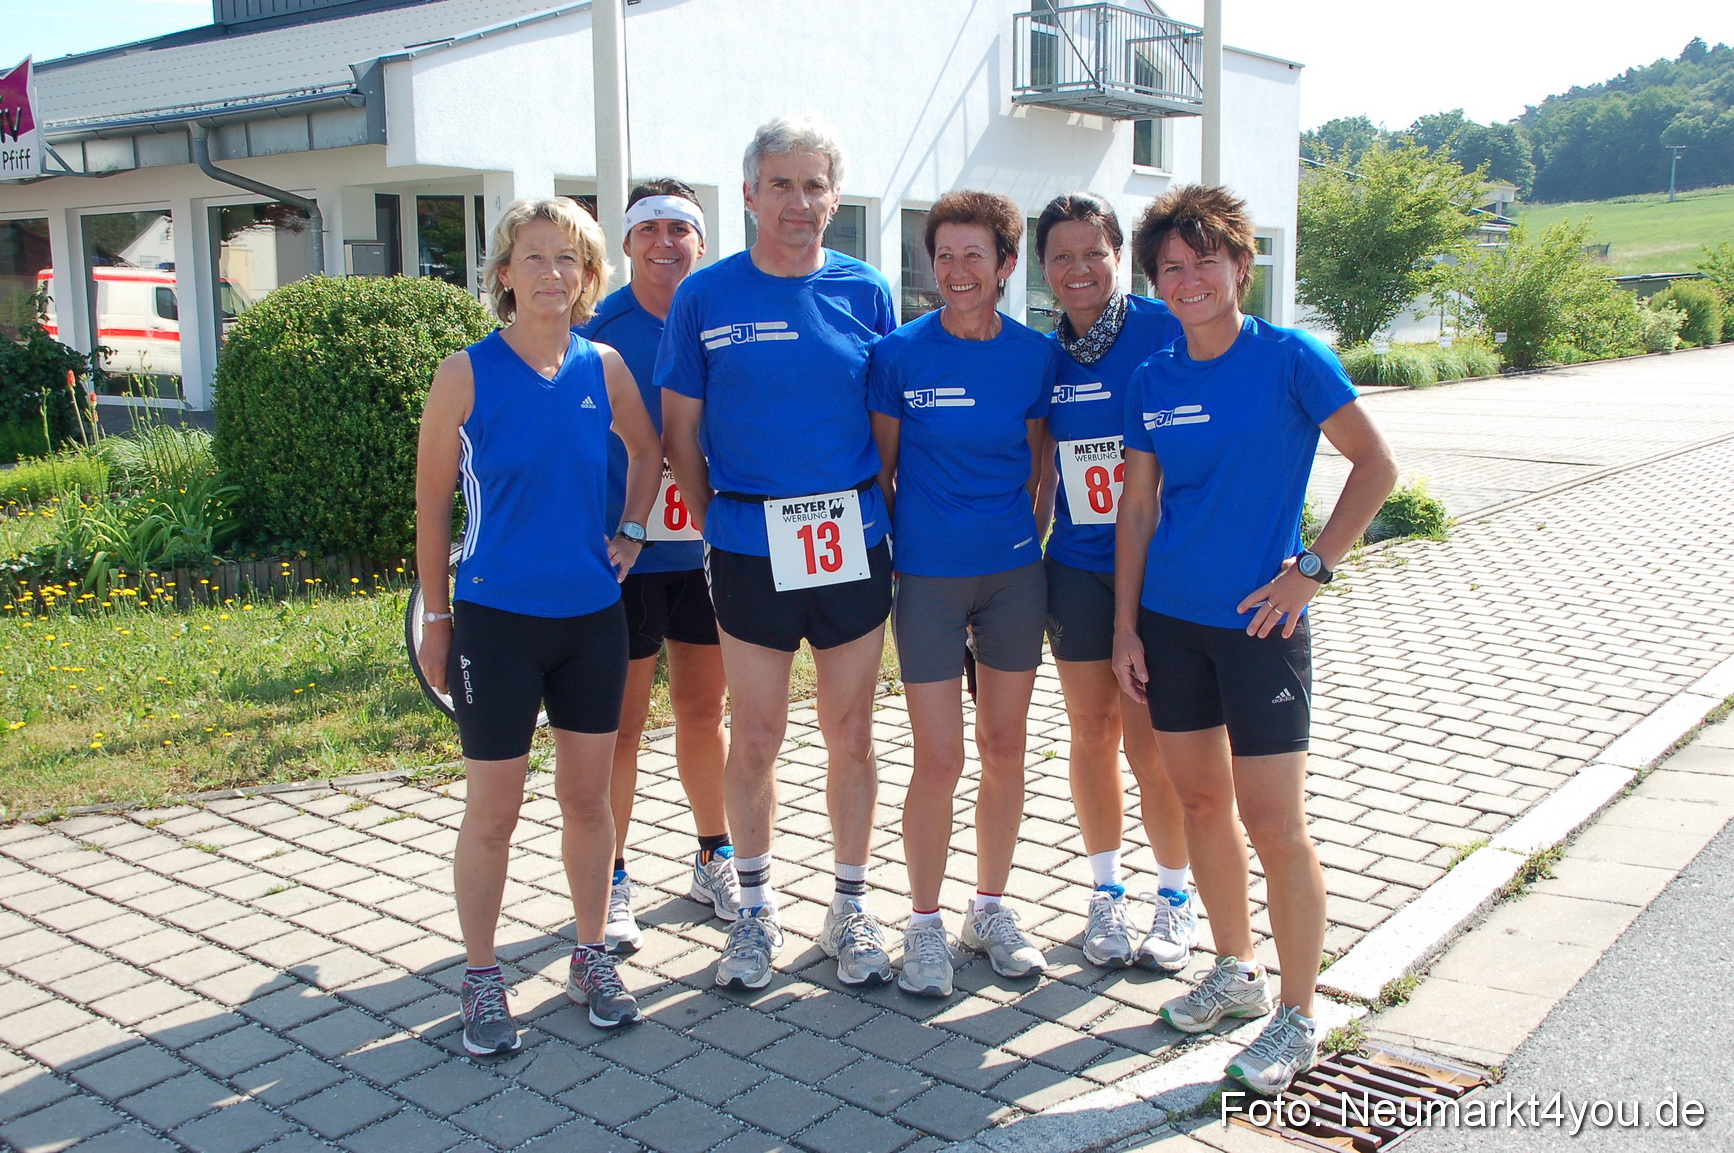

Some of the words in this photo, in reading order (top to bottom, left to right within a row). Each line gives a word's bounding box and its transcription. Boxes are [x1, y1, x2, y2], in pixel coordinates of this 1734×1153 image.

[2, 148, 31, 171] Pfiff
[1074, 441, 1116, 455] MEYER
[1074, 451, 1118, 462] WERBUNG
[663, 483, 700, 531] 8
[782, 500, 826, 516] MEYER
[782, 511, 828, 523] WERBUNG
[796, 520, 843, 575] 13
[463, 670, 473, 705] odlo
[1271, 695, 1295, 704] adidas
